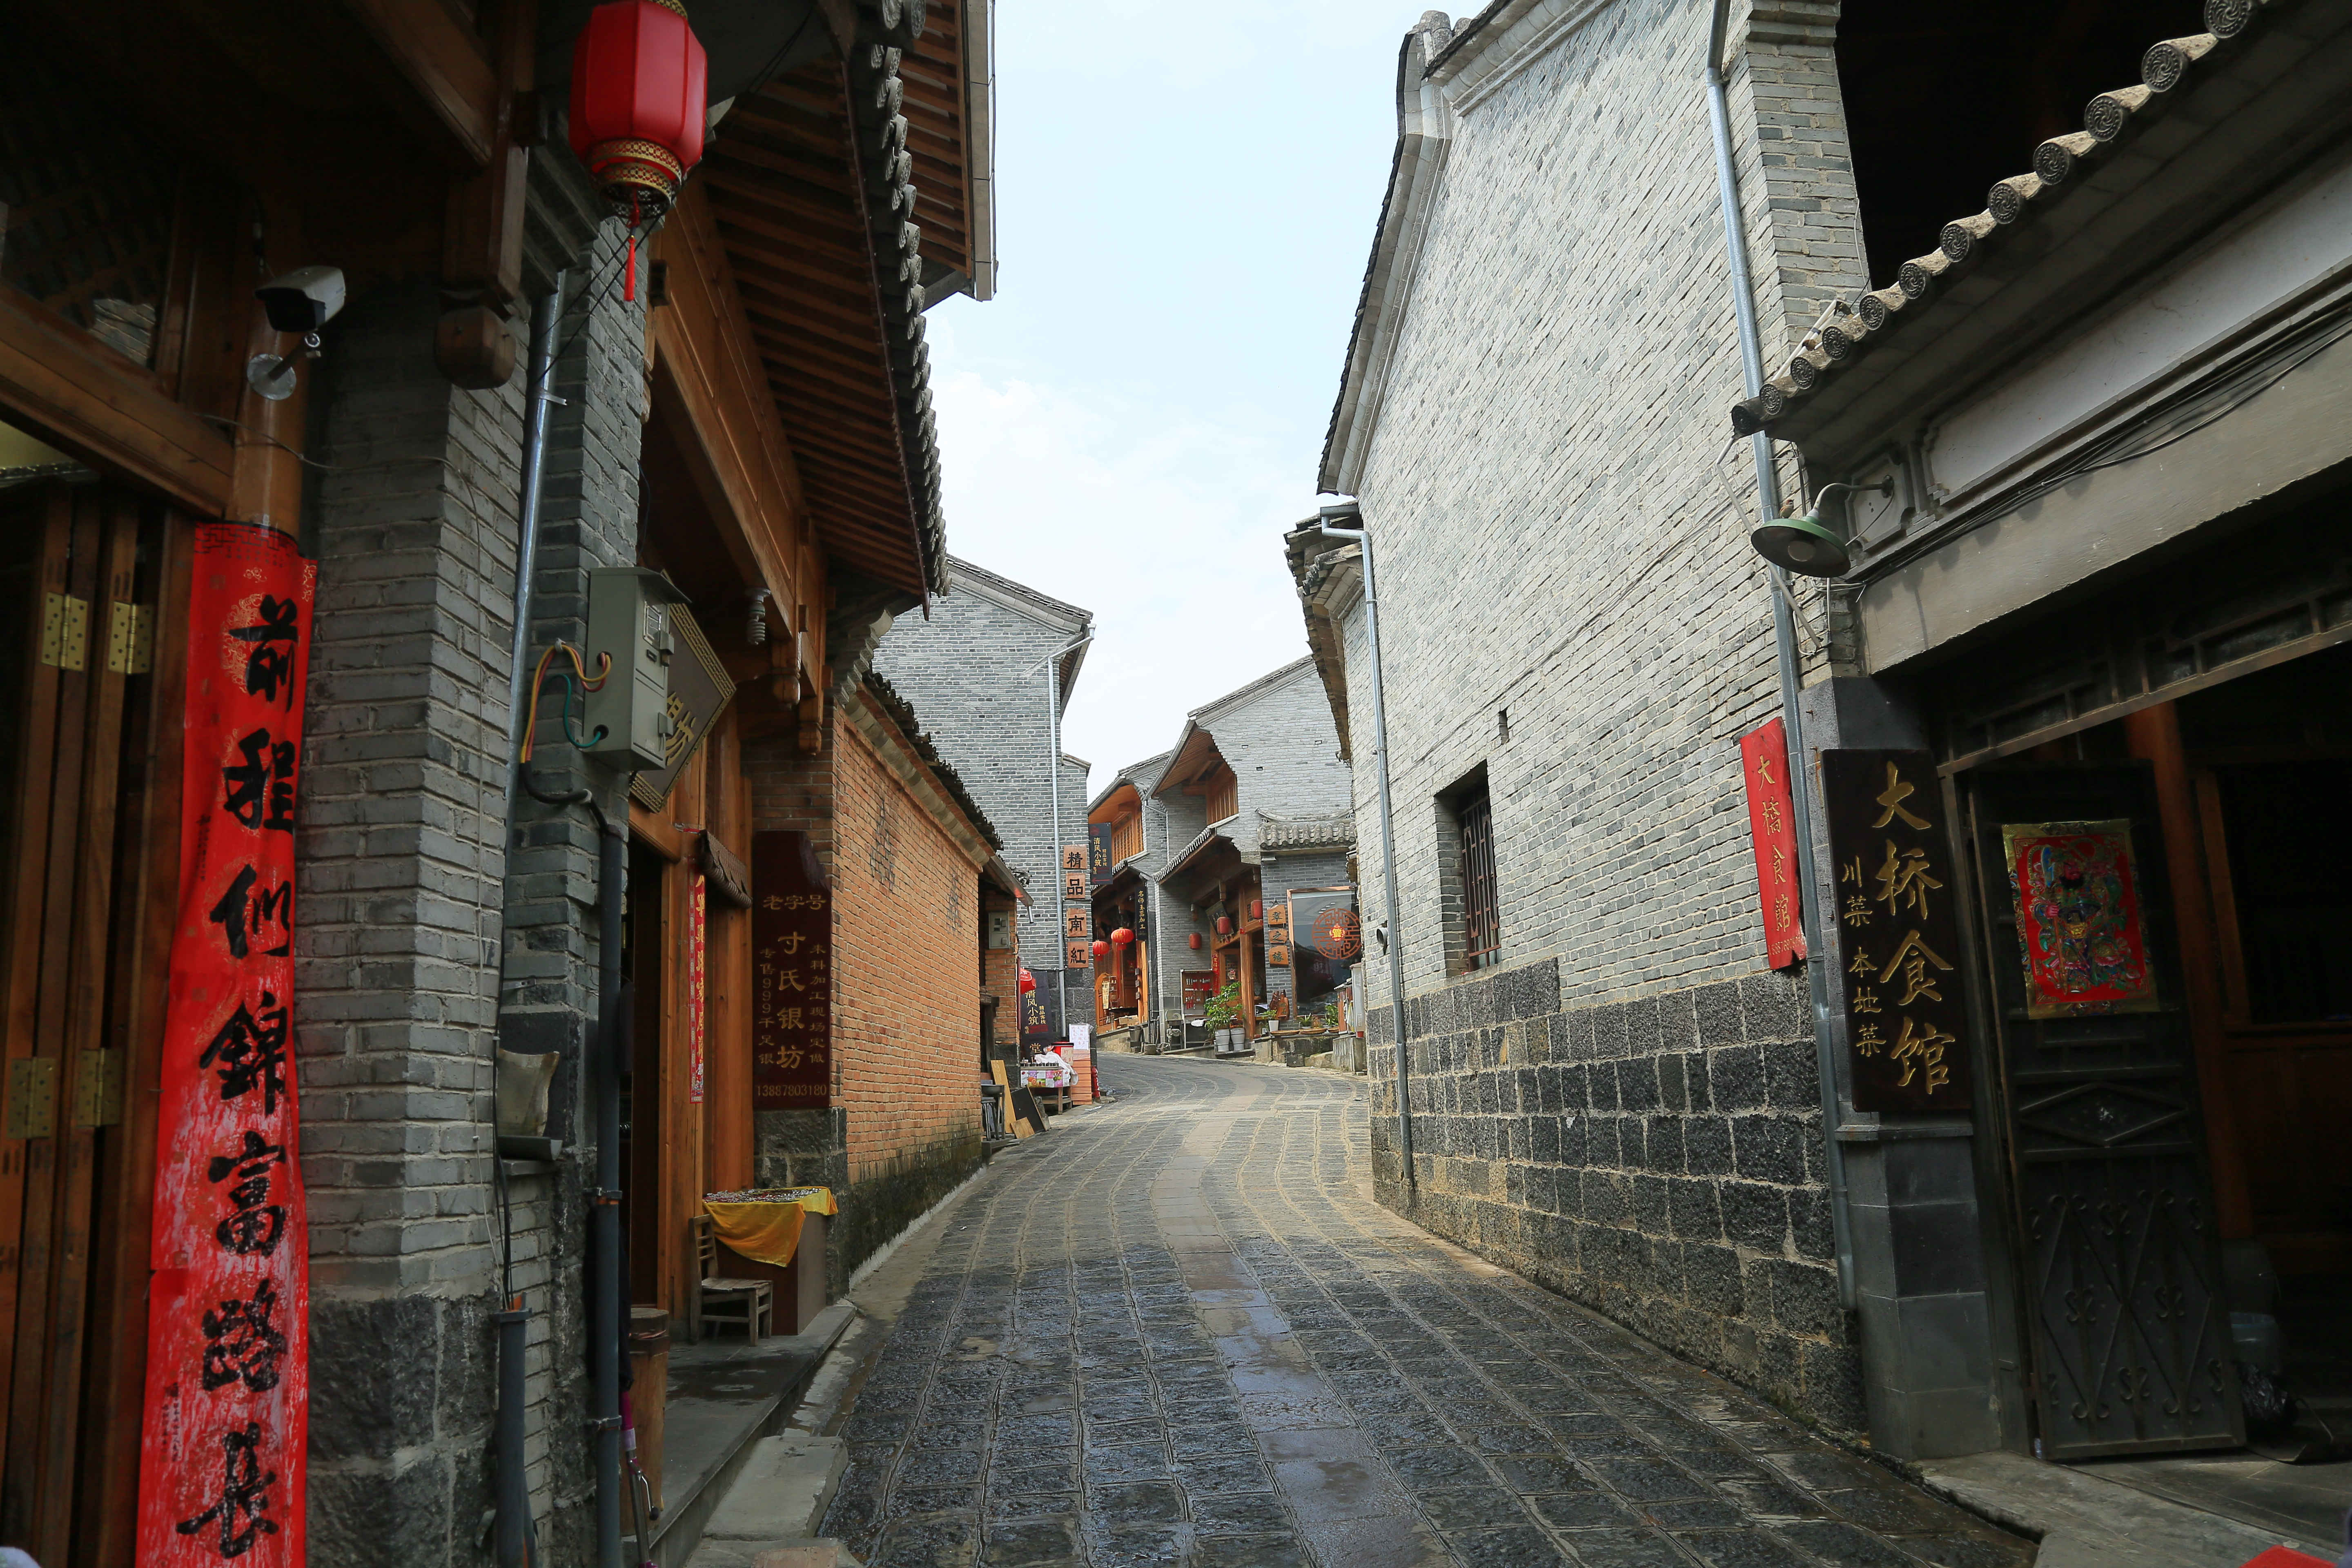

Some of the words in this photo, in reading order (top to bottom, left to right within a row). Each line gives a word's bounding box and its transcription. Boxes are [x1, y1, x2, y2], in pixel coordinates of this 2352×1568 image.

[1094, 837, 1102, 866] 清风小筑
[1757, 754, 1791, 932] 大橋食館
[1842, 855, 1872, 927] 川菜
[763, 895, 826, 910] 老字号
[1871, 760, 1956, 1094] 大桥食馆
[759, 947, 776, 1065] 专售999千足银
[777, 931, 806, 1069] 寸氏银坊
[809, 944, 826, 1064] 来料加工现场定做
[1025, 990, 1039, 1025] 清风小筑
[1848, 945, 1886, 1057] 本地菜
[757, 1084, 827, 1097] 13887803180
